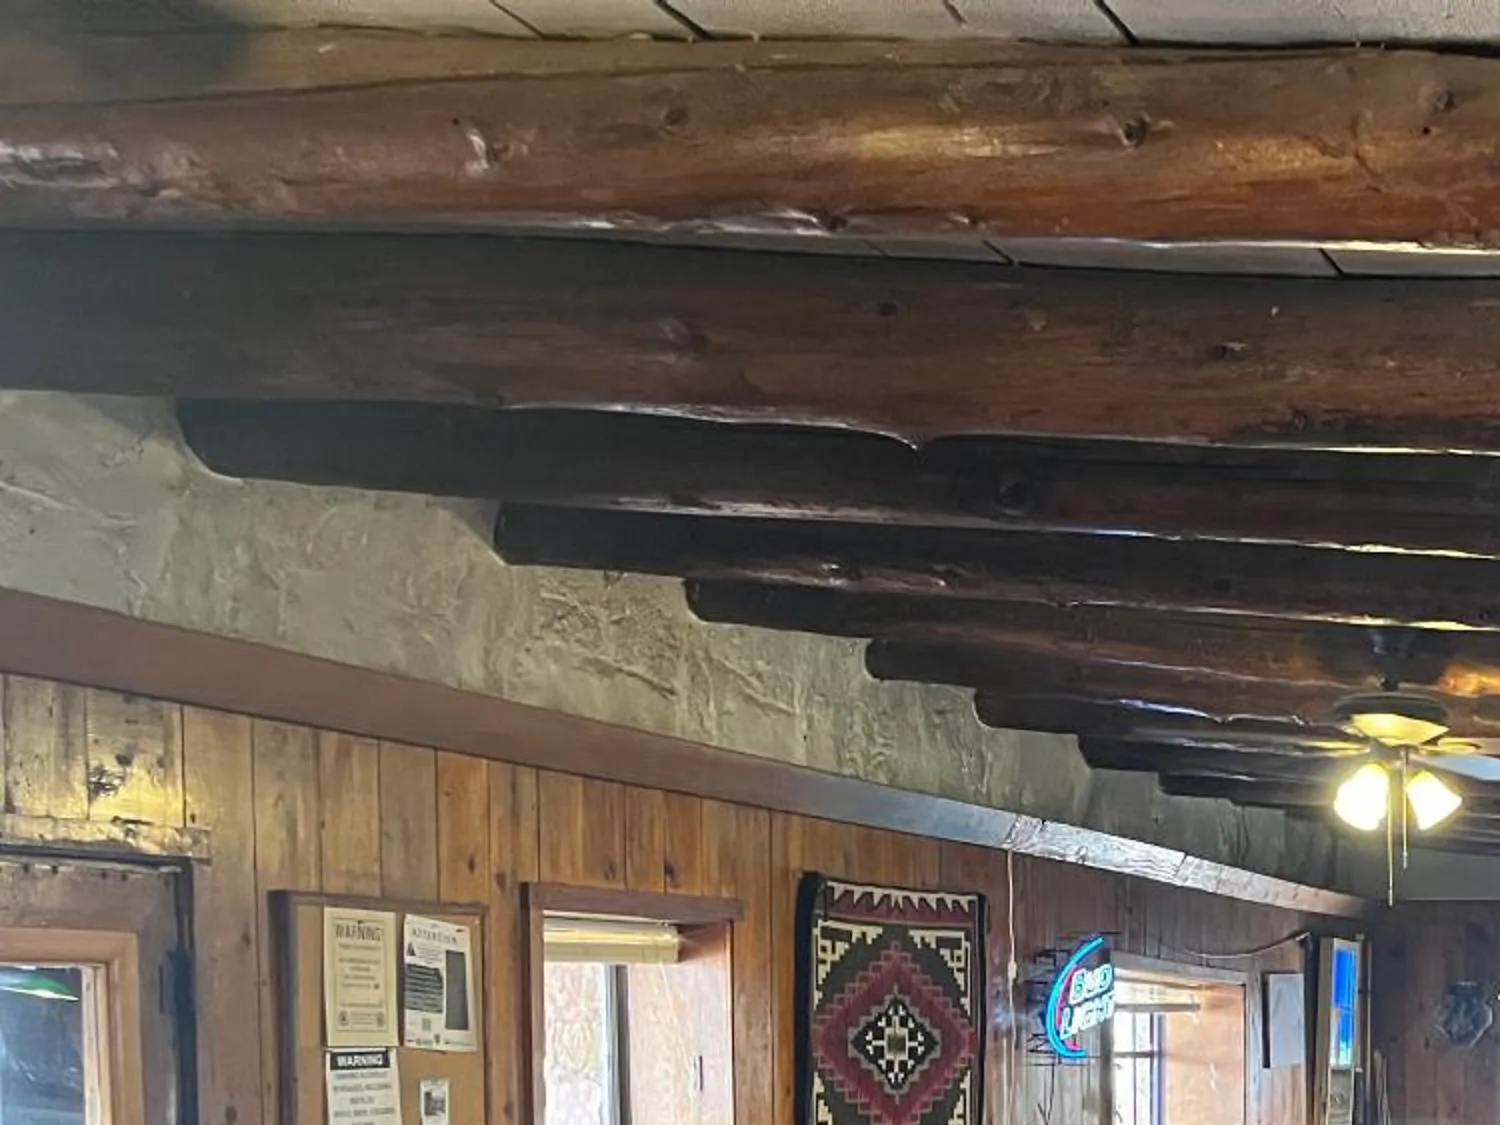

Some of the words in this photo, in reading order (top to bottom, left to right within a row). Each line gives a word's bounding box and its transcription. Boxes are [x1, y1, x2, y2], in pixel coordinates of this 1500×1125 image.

[1069, 963, 1114, 1005] BUD
[1060, 990, 1116, 1040] LIGHT
[337, 1054, 383, 1067] WARNING
